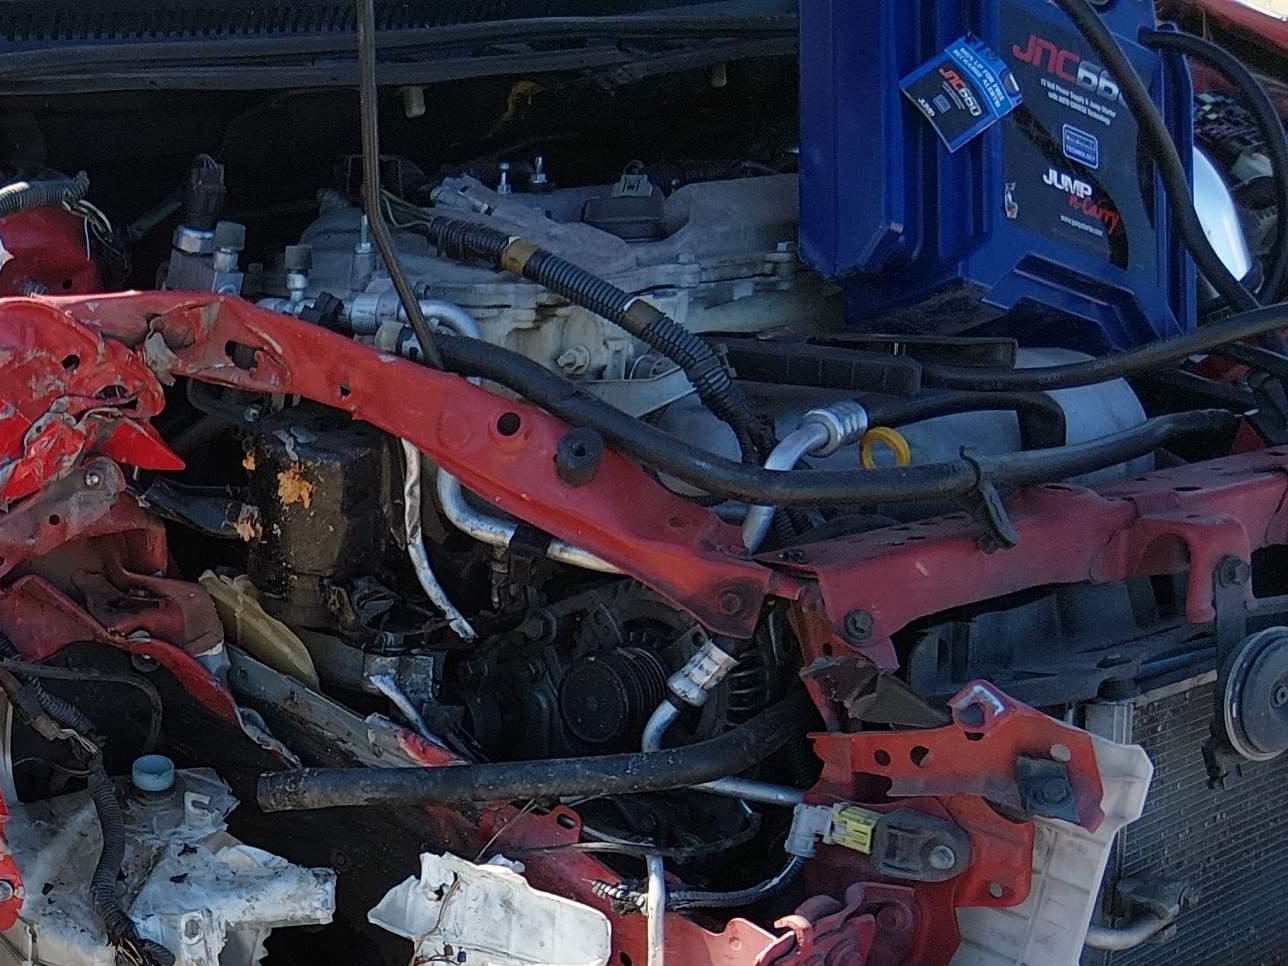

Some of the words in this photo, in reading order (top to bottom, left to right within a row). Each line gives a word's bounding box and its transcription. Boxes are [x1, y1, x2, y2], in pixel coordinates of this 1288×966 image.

[937, 67, 983, 118] JNC660
[1012, 33, 1129, 109] JNC66
[1043, 168, 1092, 199] JUMP
